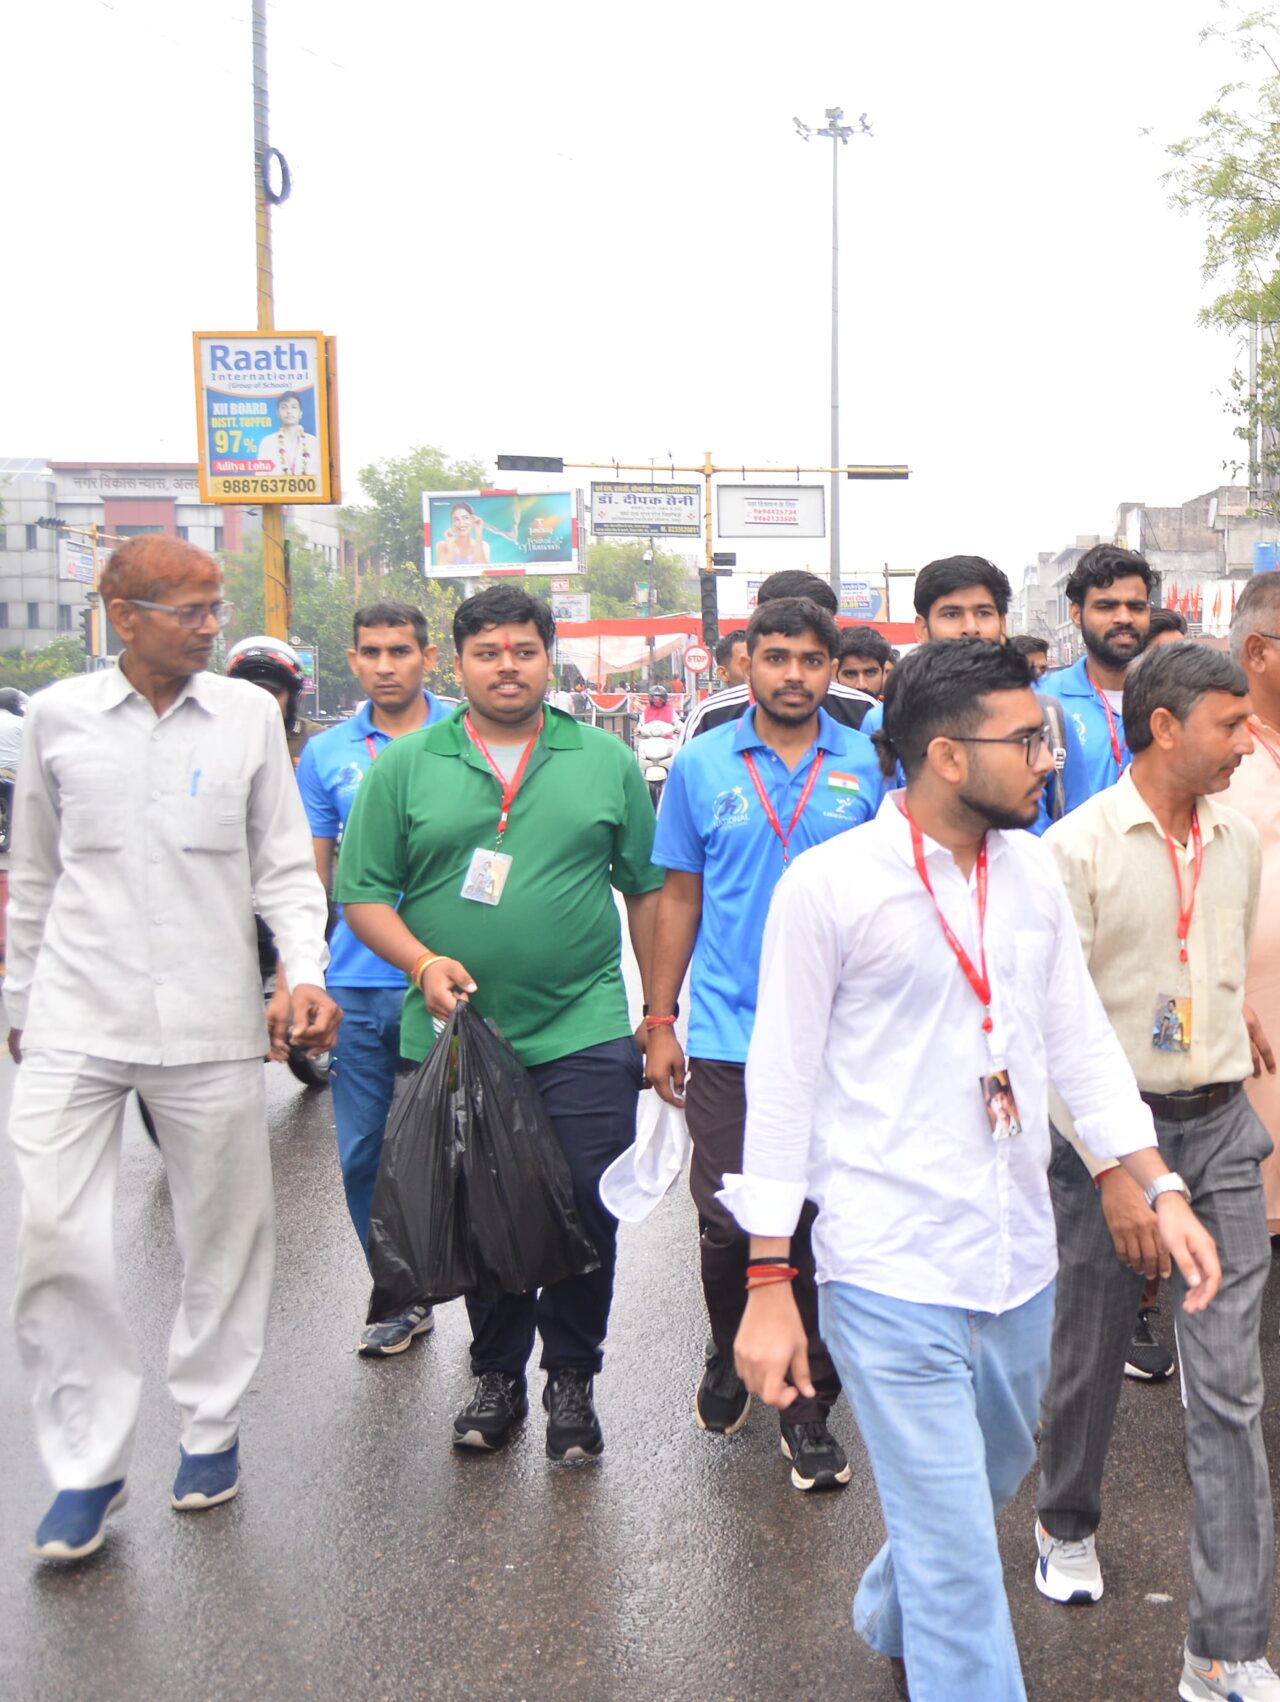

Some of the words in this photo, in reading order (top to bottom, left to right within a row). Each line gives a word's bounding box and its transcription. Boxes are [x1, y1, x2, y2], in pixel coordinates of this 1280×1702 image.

[210, 344, 308, 371] Raath
[211, 372, 309, 381] International
[213, 403, 228, 415] XII
[229, 402, 267, 415] BOARD
[240, 417, 272, 428] TOPPER
[216, 460, 245, 472] Aditya
[74, 477, 97, 489] नगर
[99, 473, 136, 489] विकास
[171, 477, 199, 489] अलव
[223, 479, 316, 493] 9887637800
[598, 494, 617, 504] डॉ.
[624, 495, 662, 505] दीपक
[666, 495, 695, 506] सैनी
[688, 655, 706, 663] STOP
